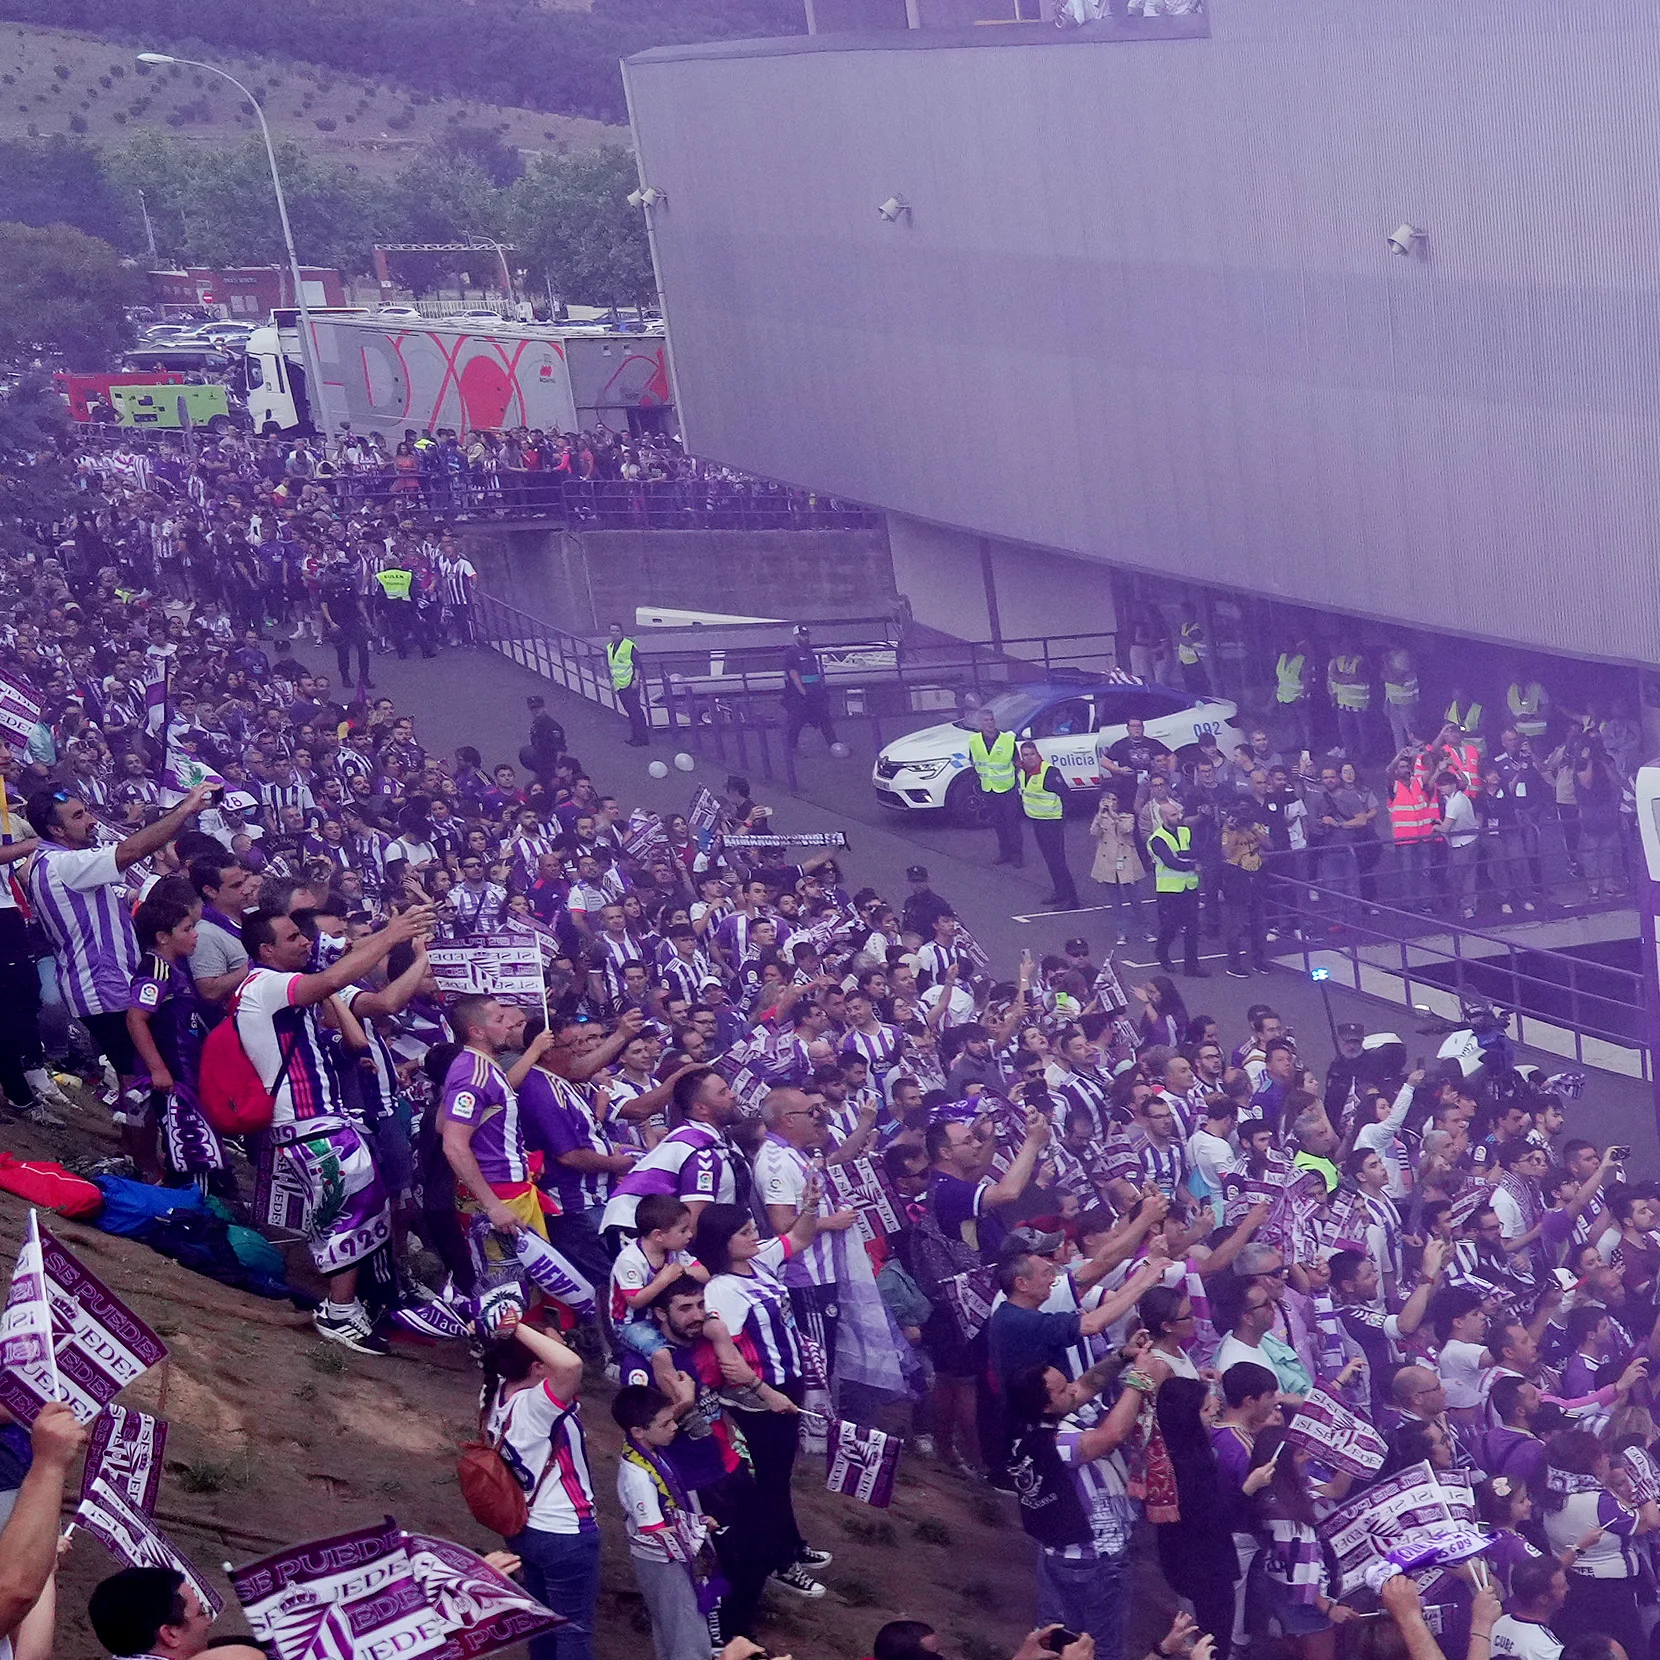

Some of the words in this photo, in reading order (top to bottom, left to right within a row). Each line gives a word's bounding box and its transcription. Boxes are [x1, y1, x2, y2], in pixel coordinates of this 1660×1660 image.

[1193, 720, 1222, 738] 092
[1051, 750, 1095, 768] Policía
[75, 1280, 162, 1363] PUEDE!
